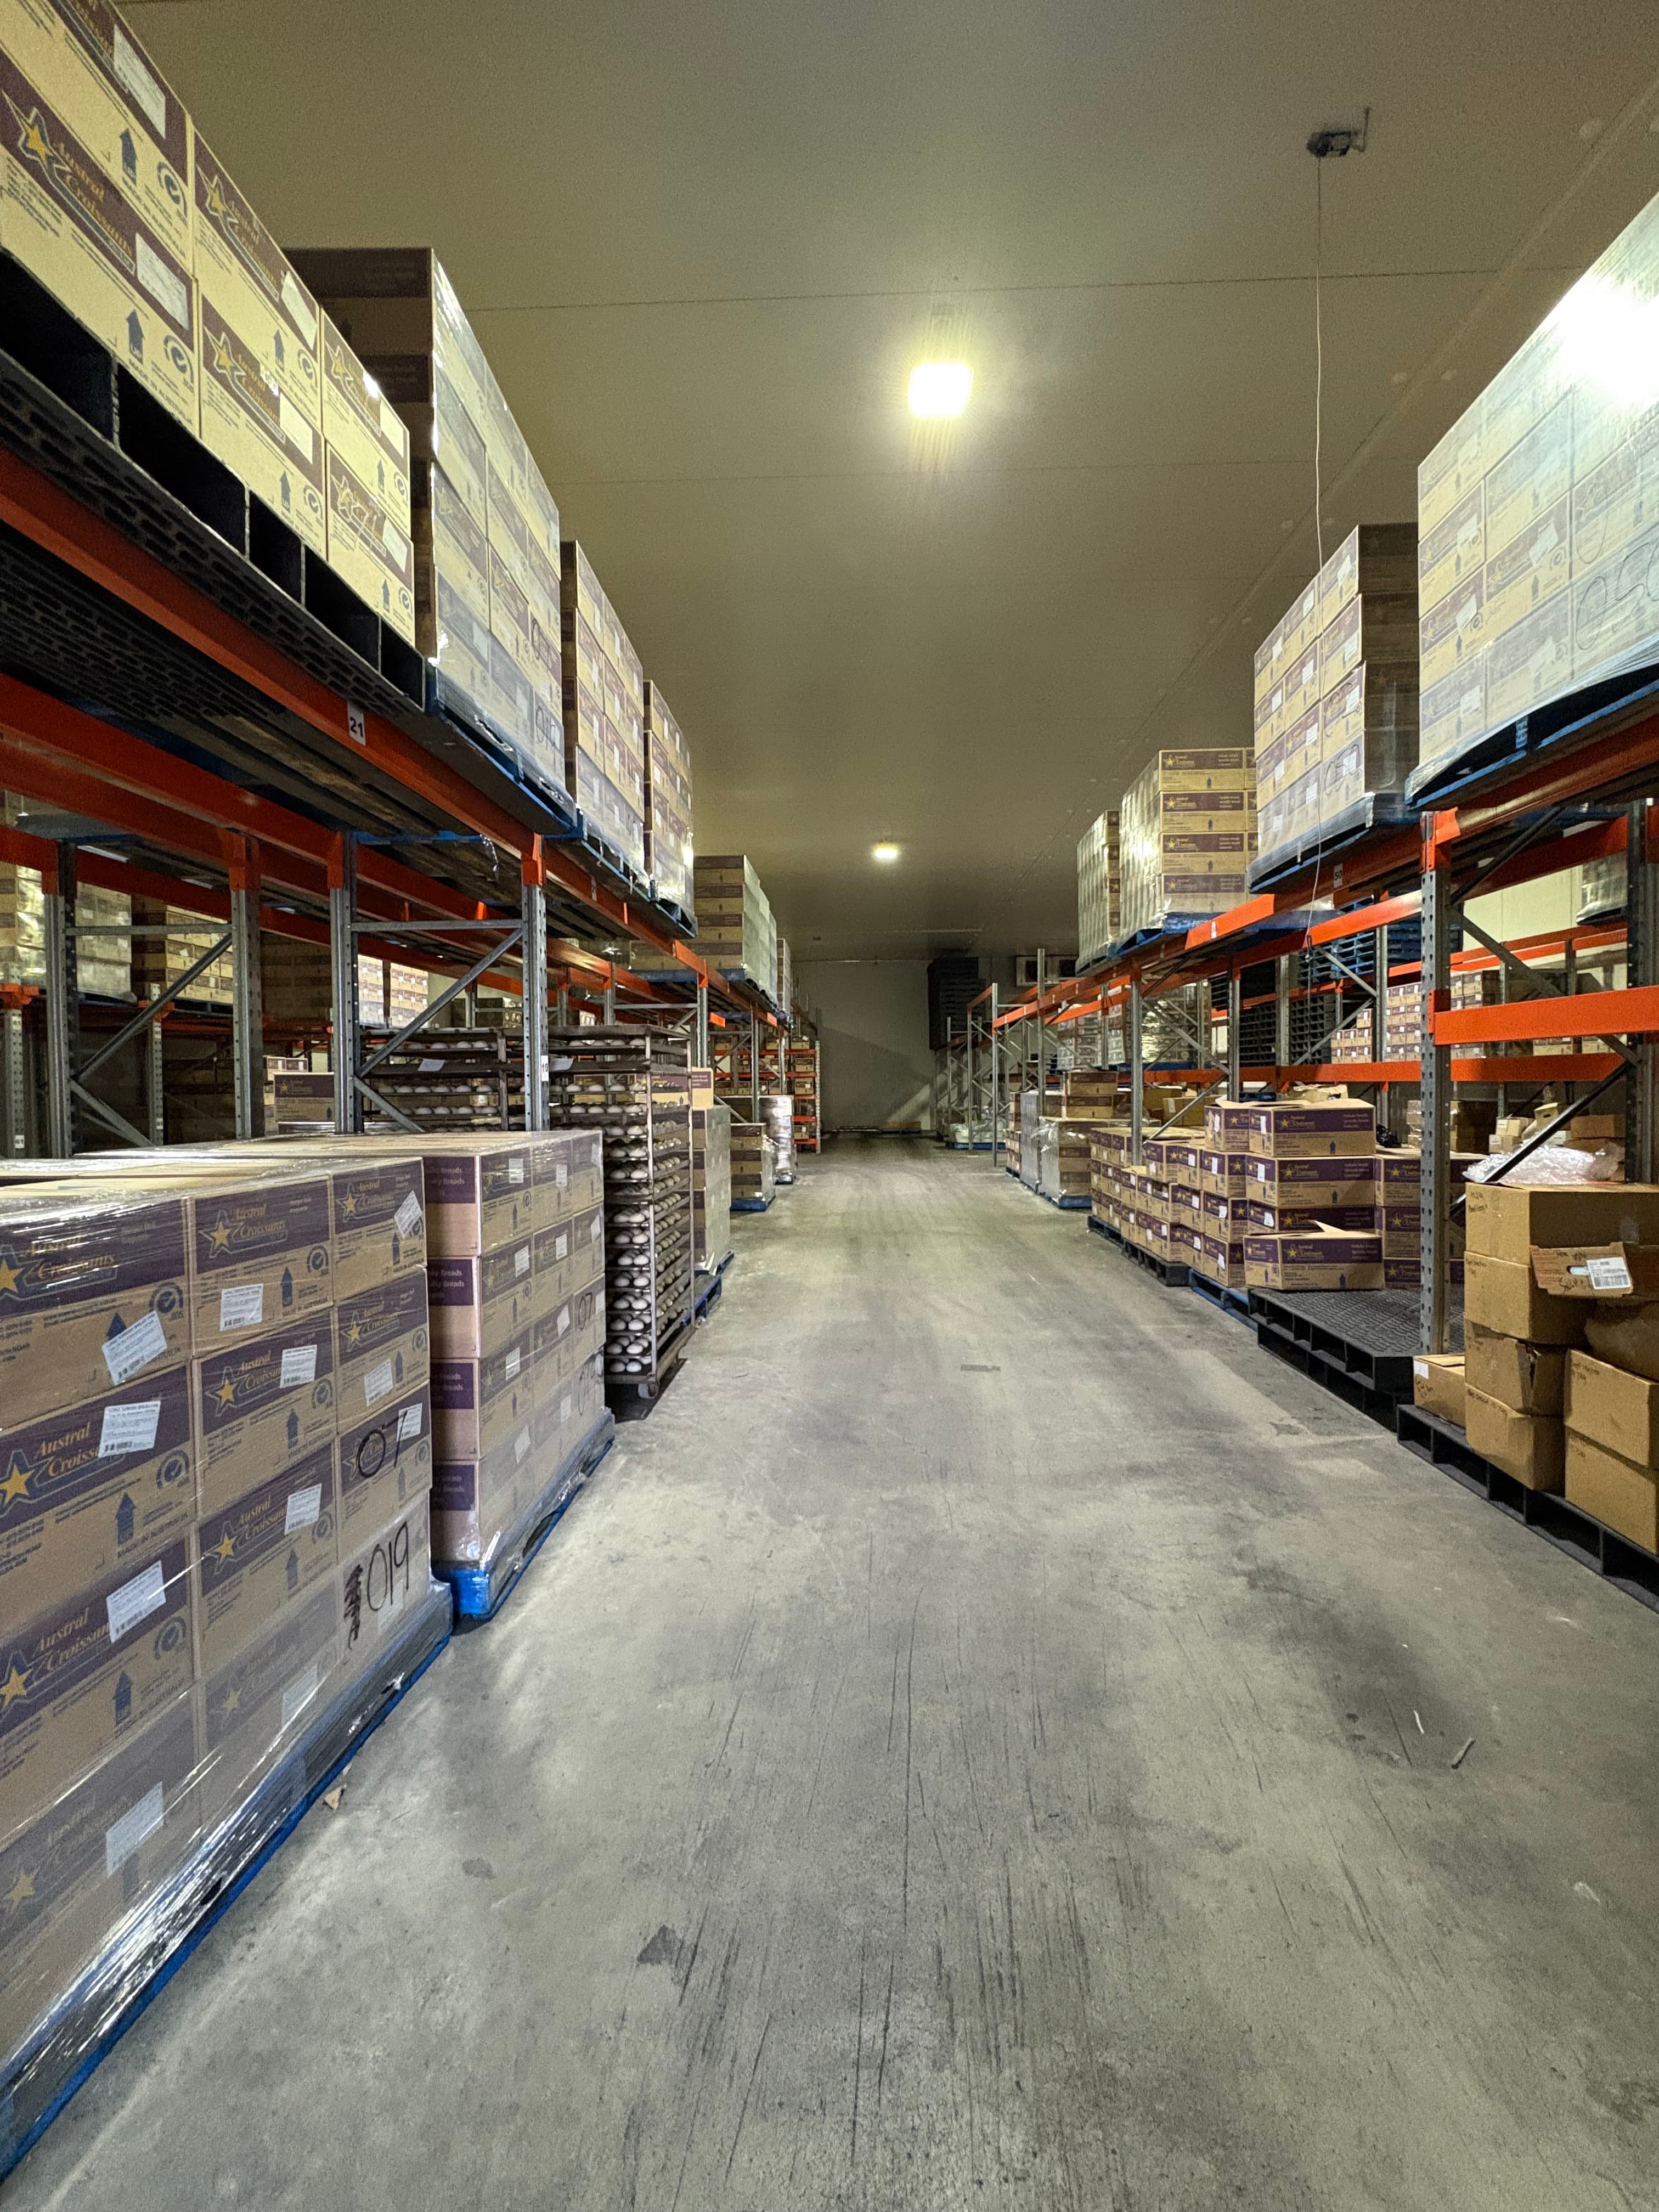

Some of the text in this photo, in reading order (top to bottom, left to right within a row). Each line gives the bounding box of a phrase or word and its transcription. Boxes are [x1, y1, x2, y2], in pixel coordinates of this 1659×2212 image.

[54, 142, 105, 201] Austral
[350, 716, 363, 737] 21
[541, 1063, 548, 1073] 10
[230, 1203, 267, 1221] Austral
[241, 1220, 286, 1237] Croissants
[237, 1347, 271, 1373] Austral
[34, 1422, 91, 1457] Austral
[238, 1494, 270, 1524] Austral
[367, 1521, 409, 1612] 019
[33, 1607, 89, 1654] Austral
